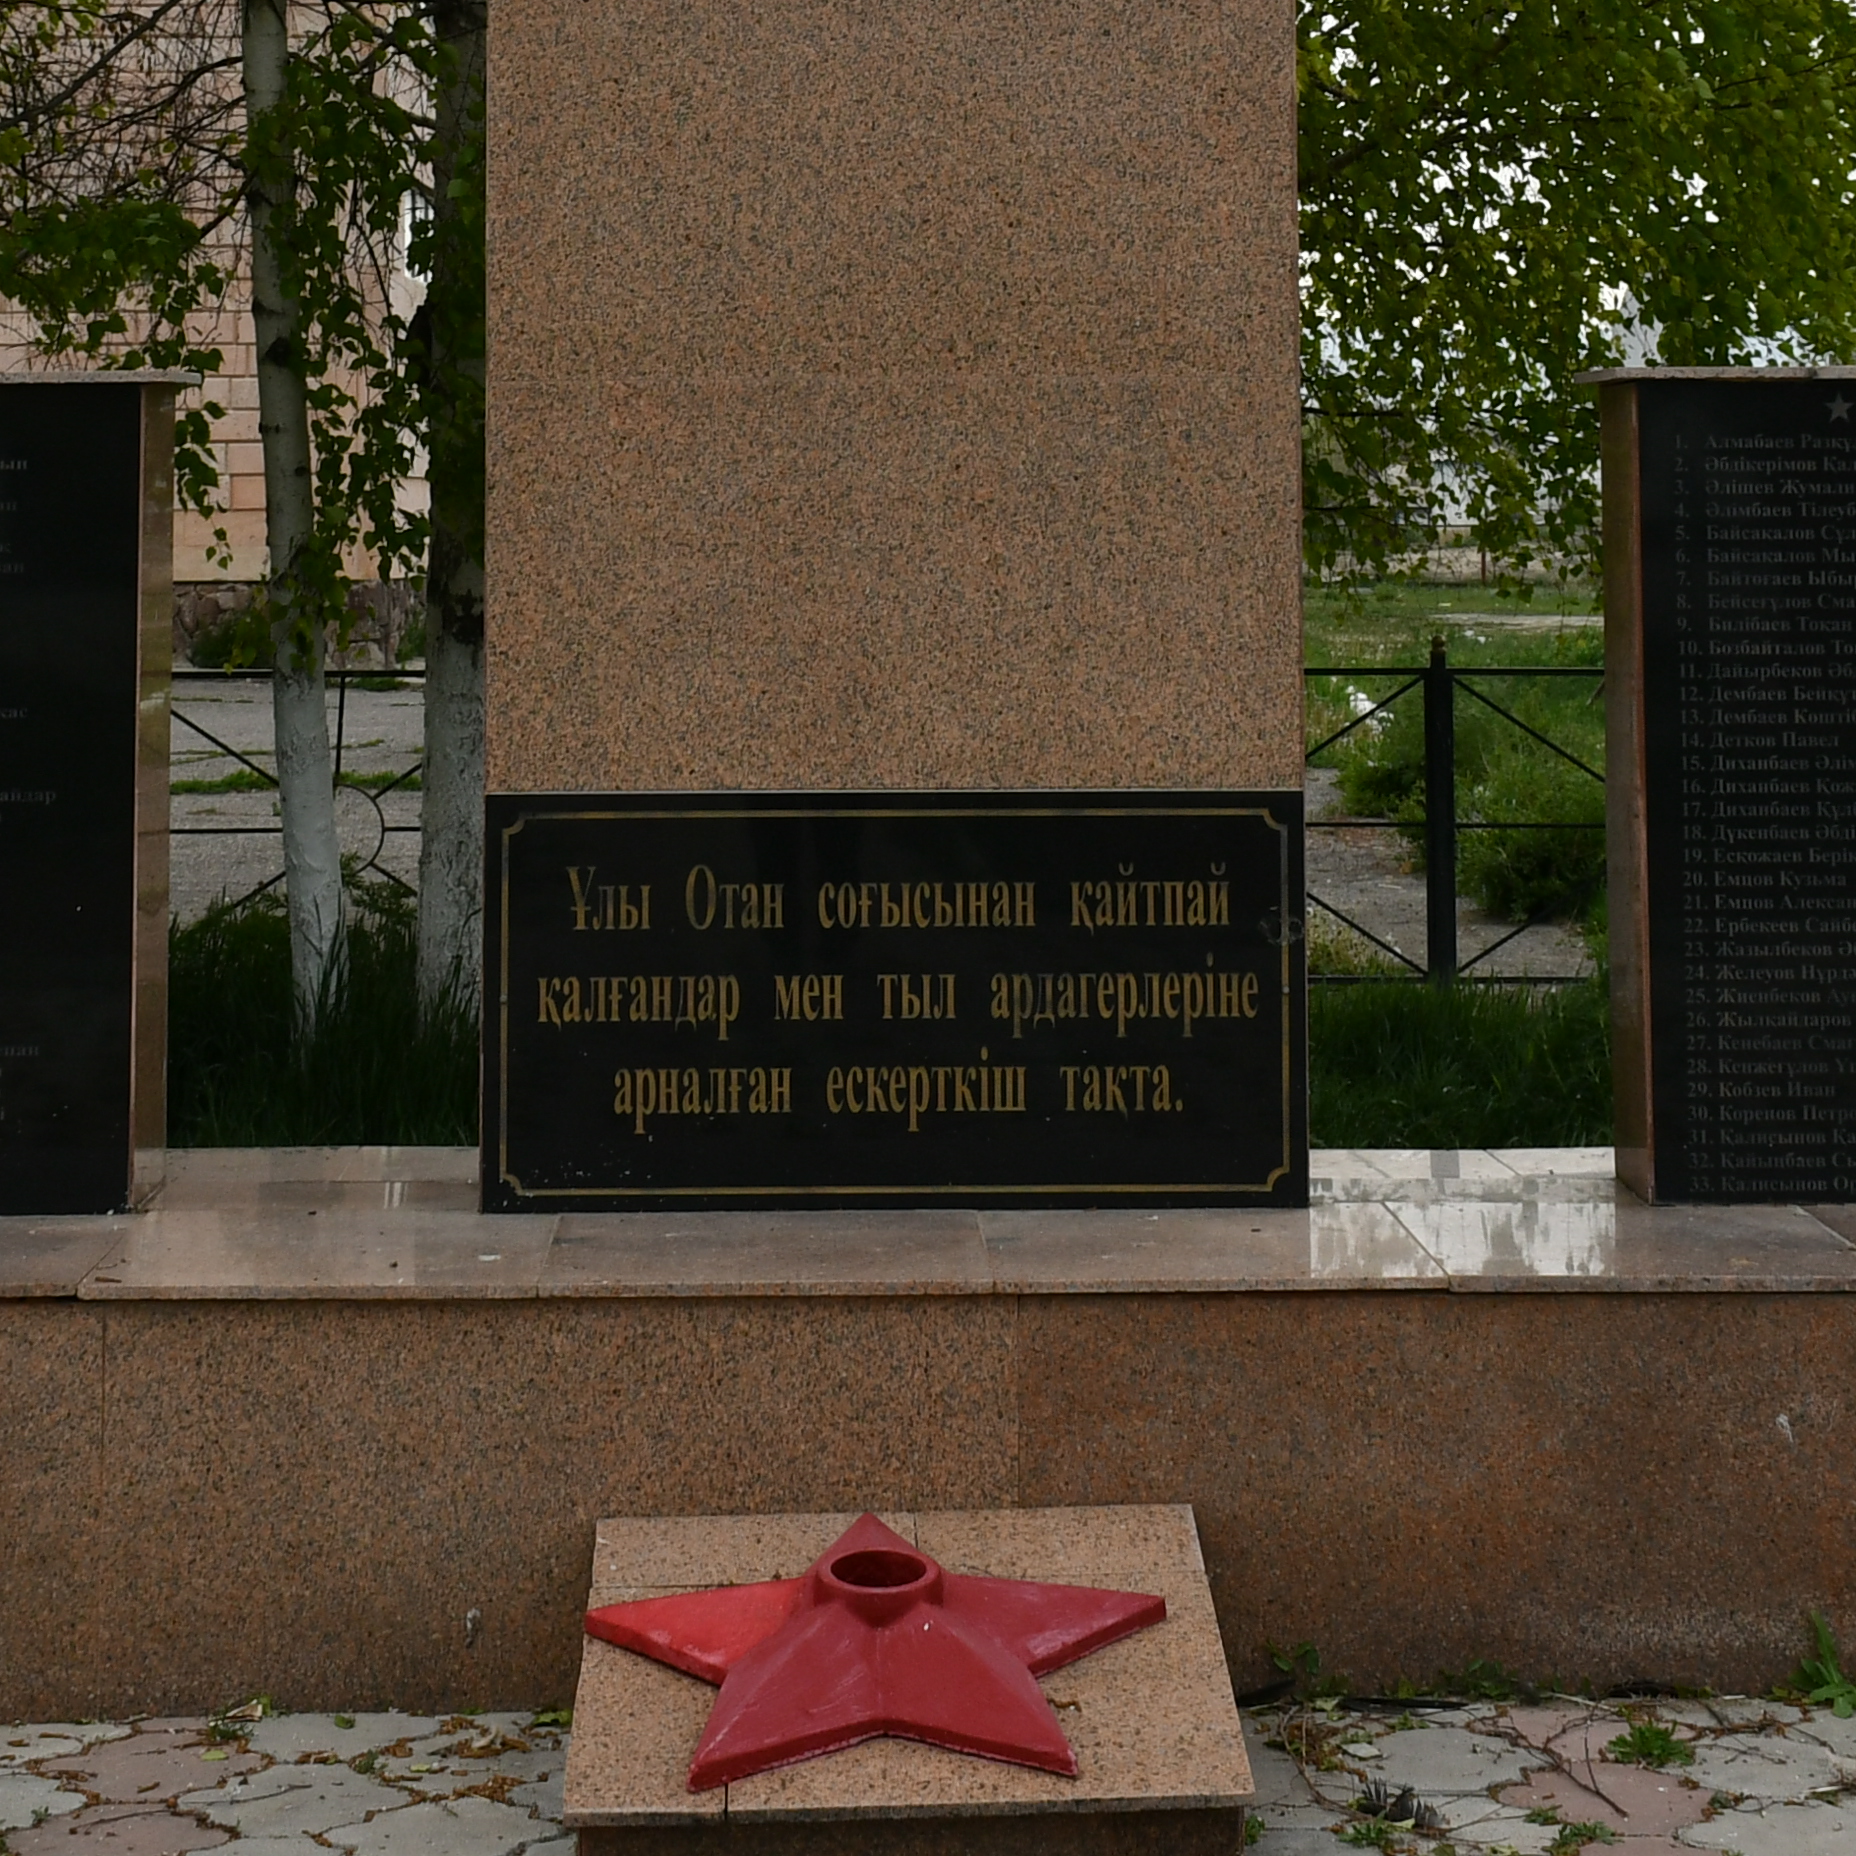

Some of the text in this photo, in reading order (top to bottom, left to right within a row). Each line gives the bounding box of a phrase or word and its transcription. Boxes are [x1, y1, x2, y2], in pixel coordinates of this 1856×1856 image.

[1674, 457, 1689, 472] 2.
[1674, 480, 1690, 495] 3.
[1674, 502, 1690, 517] 4.
[1676, 571, 1691, 586] 7.
[1678, 641, 1703, 656] 10.
[1680, 733, 1705, 748] 14.
[1681, 756, 1705, 771] 15.
[1683, 825, 1706, 840] 18.
[1683, 872, 1708, 887] 20.
[568, 862, 1230, 934] Ұлы Отан соғысынан қайтпай
[1683, 895, 1708, 910] 21.
[1683, 918, 1709, 933] 22.
[537, 954, 1259, 1041] қалғандар мен тыл ардагерлеріне
[614, 1046, 1184, 1135] арналған ескерткіш тақта.
[1687, 1083, 1713, 1098] 29.
